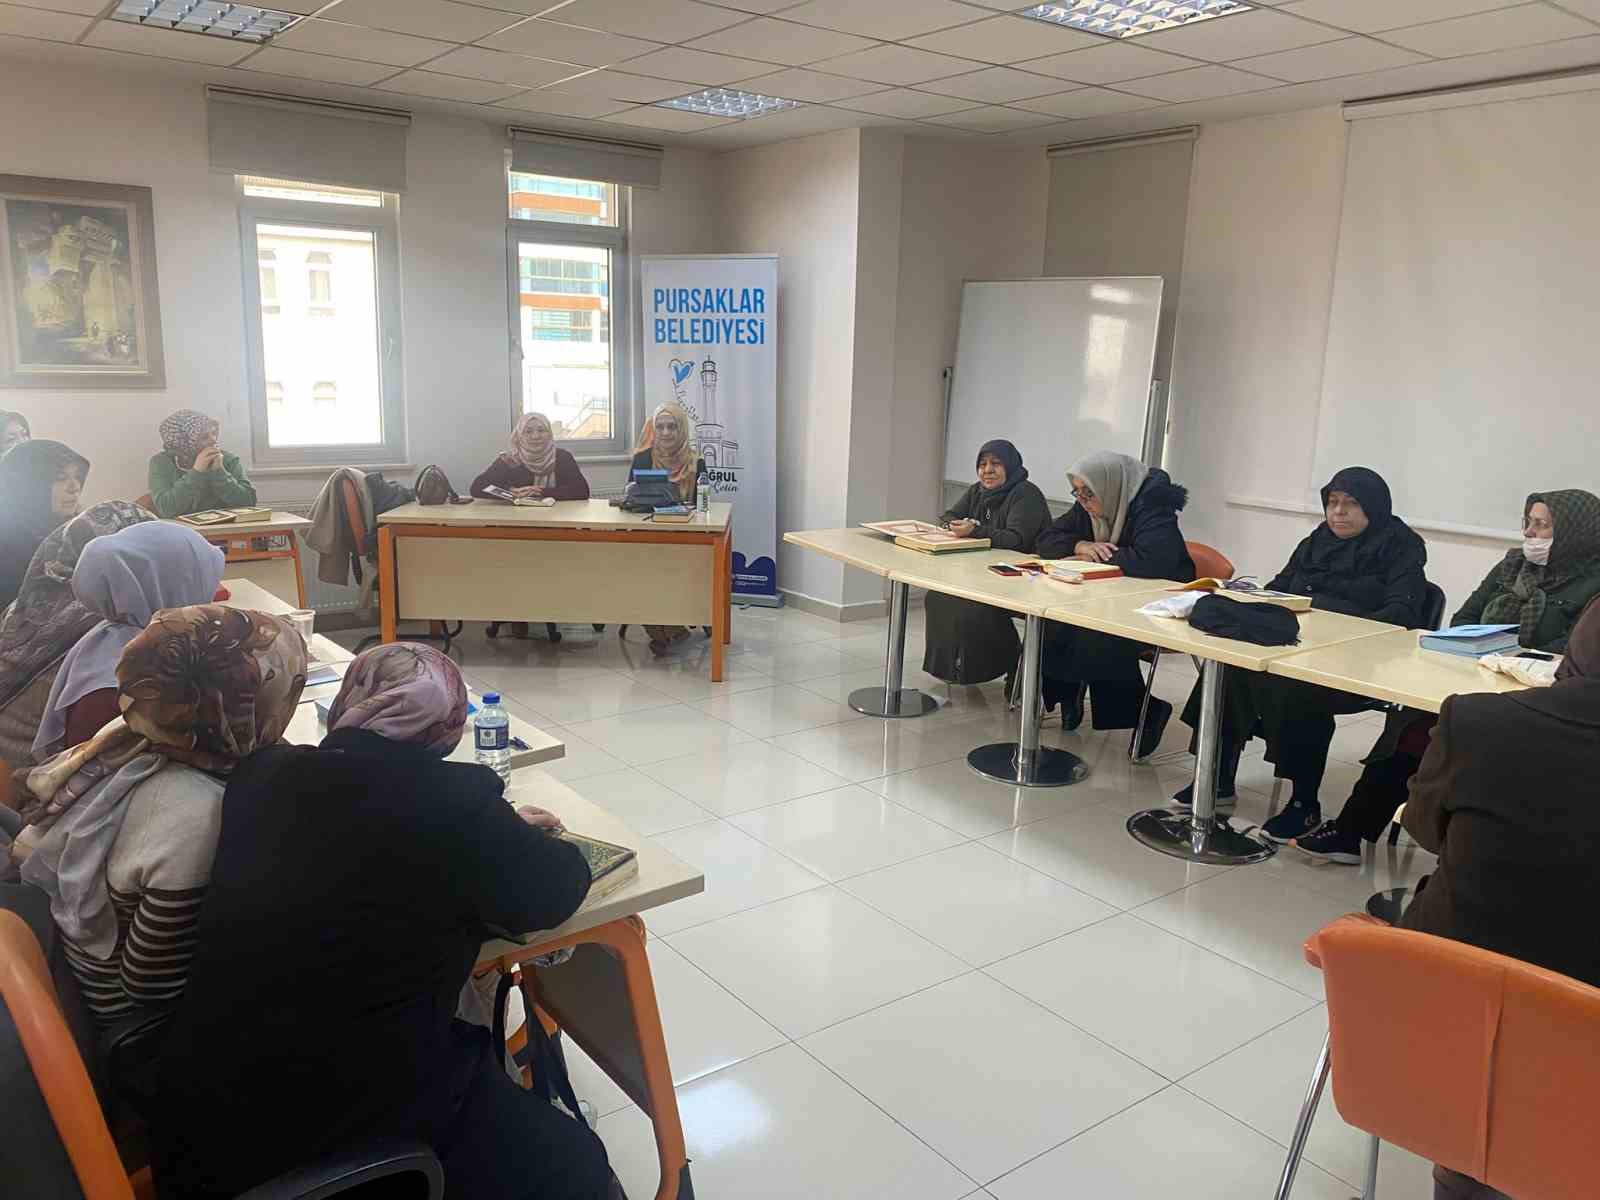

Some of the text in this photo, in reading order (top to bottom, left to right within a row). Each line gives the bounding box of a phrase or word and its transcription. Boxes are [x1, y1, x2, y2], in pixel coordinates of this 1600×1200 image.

[654, 288, 764, 313] PURSAKLAR
[655, 318, 764, 344] BELEDİYESİ
[708, 469, 737, 482] ĞRUL
